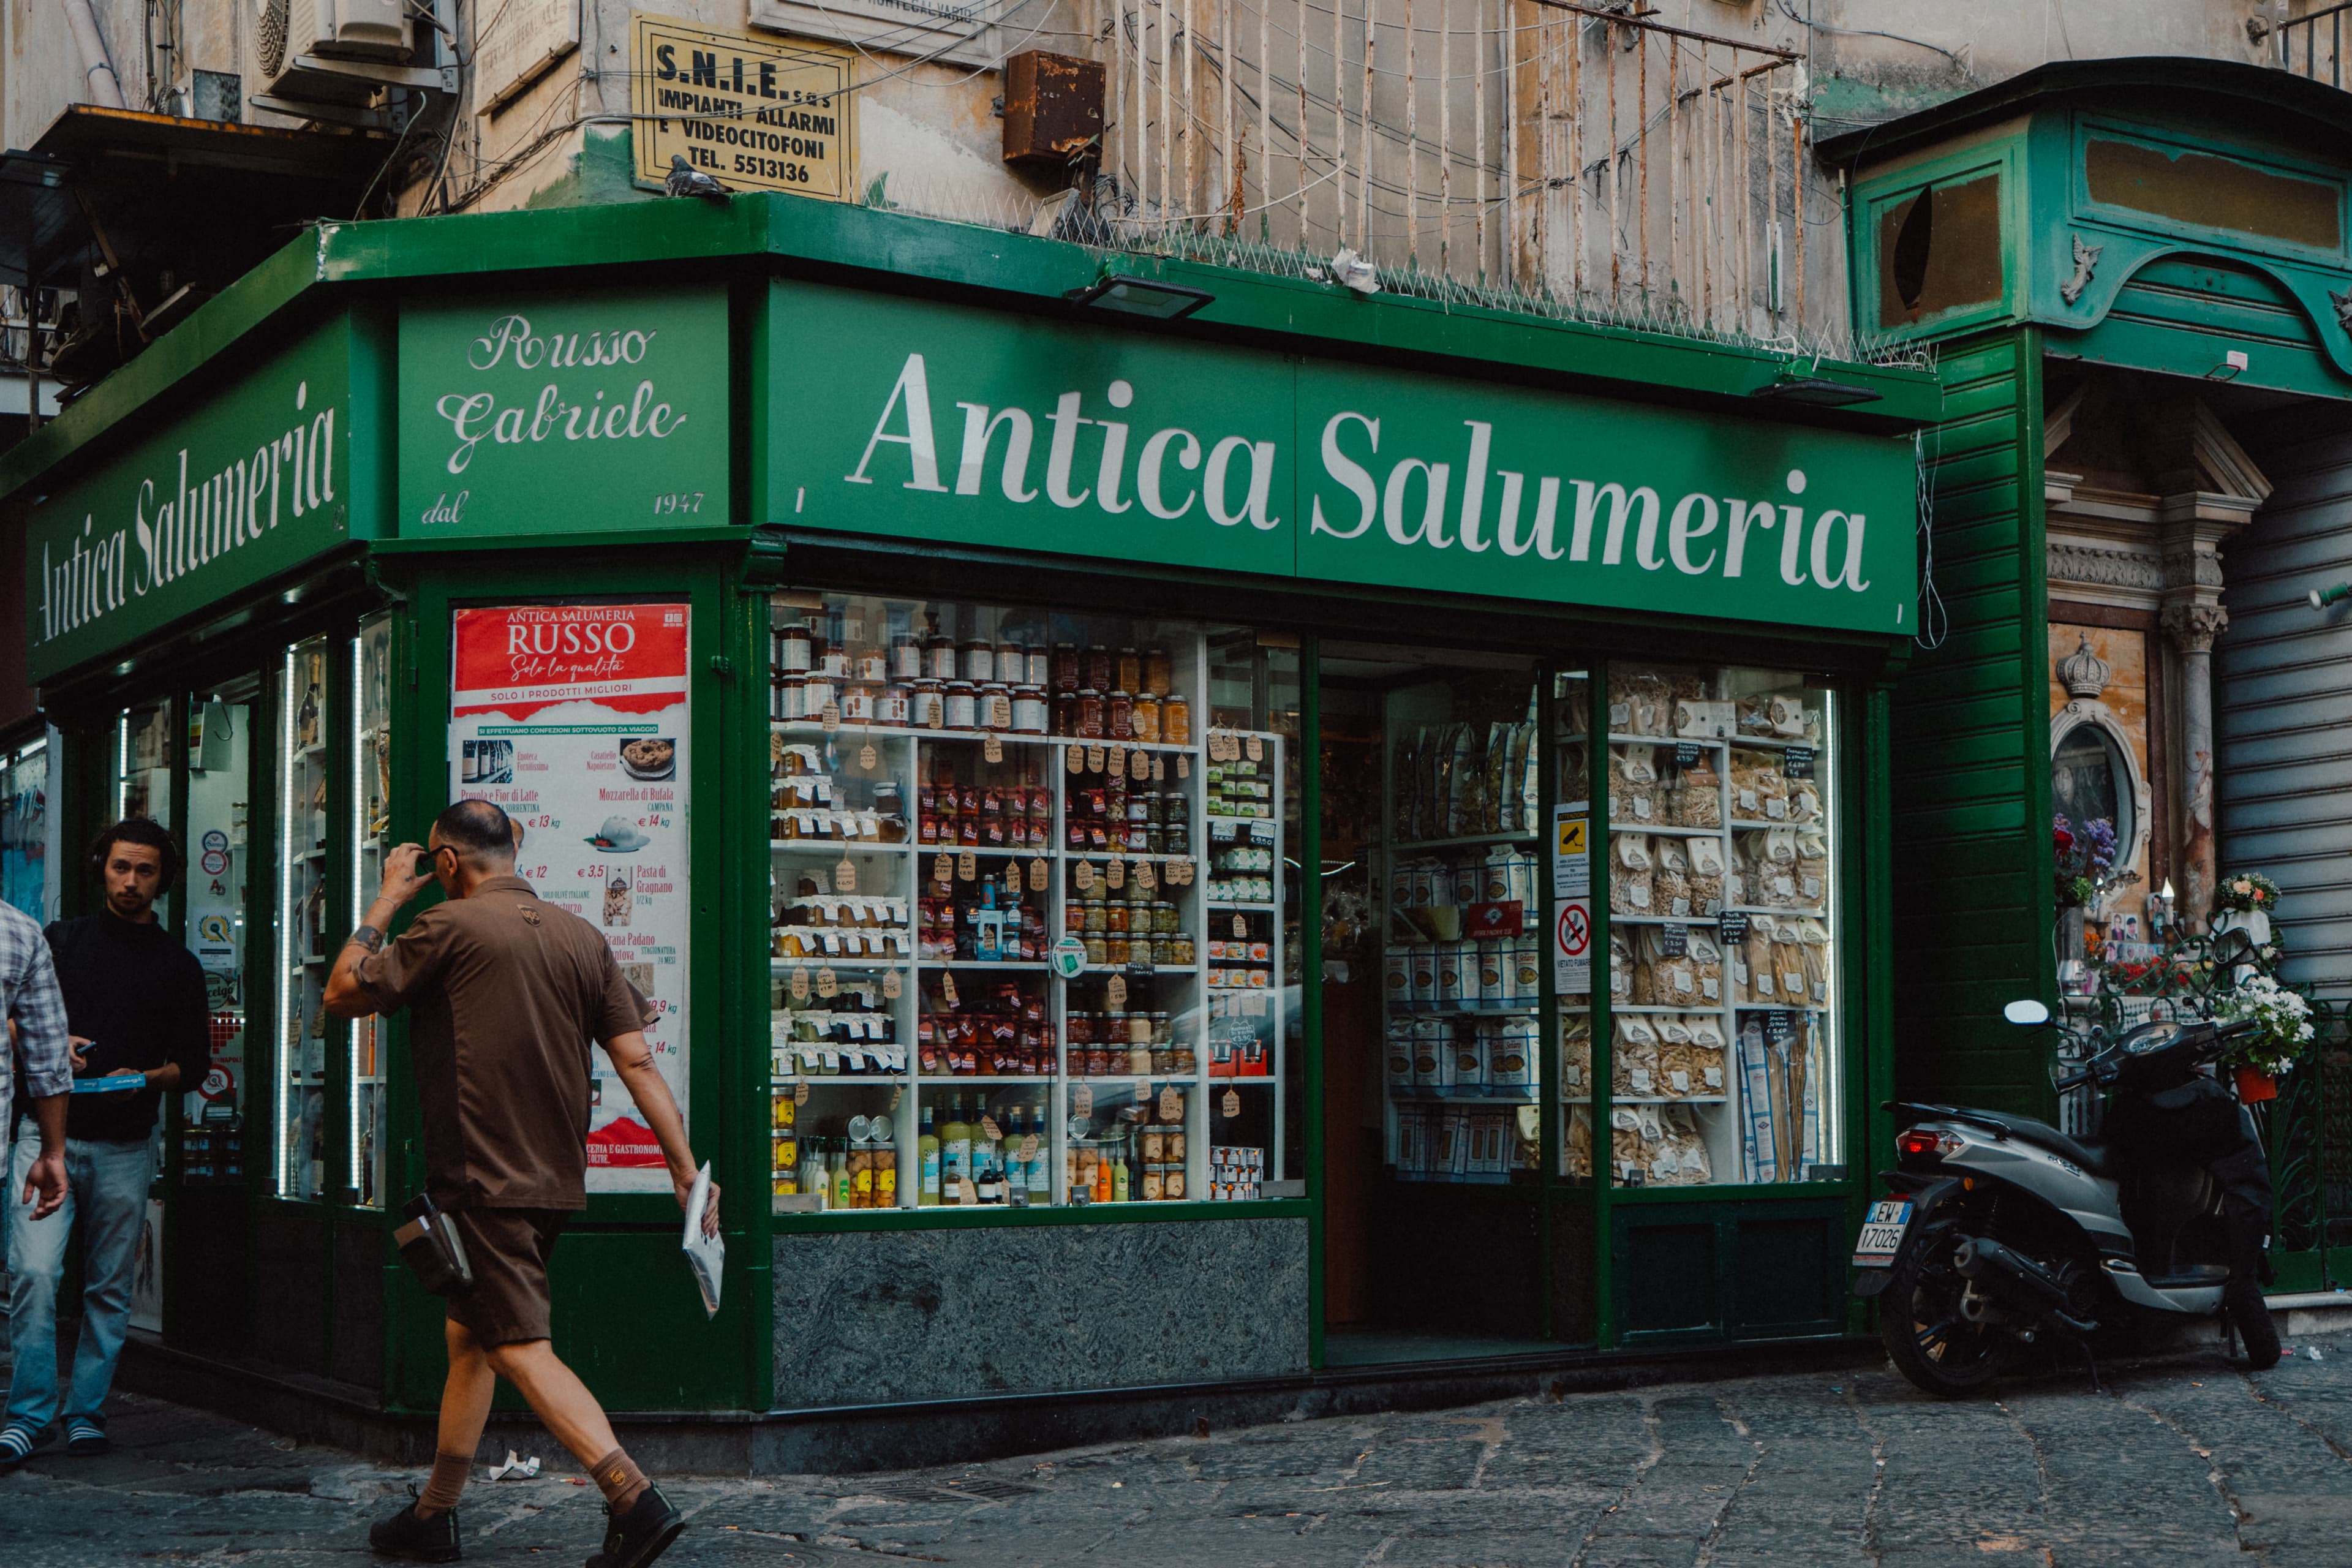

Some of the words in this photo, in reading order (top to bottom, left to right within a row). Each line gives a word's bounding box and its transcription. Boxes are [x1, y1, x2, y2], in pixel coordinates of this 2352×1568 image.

[658, 88, 742, 120] IMPIANTI
[756, 105, 835, 135] ALLARMI
[659, 118, 669, 133] E
[681, 118, 824, 159] VIDEOCITOFONI
[688, 146, 725, 170] TEL.
[734, 154, 809, 183] 5513136
[469, 313, 657, 370] Russo
[436, 379, 688, 473] Gabriele
[844, 353, 1281, 530] Antica
[1311, 411, 1871, 593] Salumeria
[34, 513, 126, 647] Antica
[135, 380, 335, 597] Salumeria
[421, 490, 469, 524] dal
[654, 492, 704, 514] 1947
[507, 611, 557, 623] ANTICA
[561, 609, 635, 622] SALUMERIA
[507, 622, 635, 654] RUSSO
[511, 654, 545, 682] Solo
[548, 657, 569, 675] la
[570, 654, 624, 682] qualità
[491, 692, 518, 701] SOLO
[529, 687, 581, 699] PRODOTTI
[585, 684, 632, 695] MIGLIORI
[518, 752, 538, 761] Enoteca
[591, 750, 616, 760] Casatiello
[517, 762, 549, 771] Fornitissima
[587, 761, 616, 771] Napoletano
[461, 789, 488, 801] Provola
[489, 792, 494, 801] e
[495, 789, 510, 802] Fior
[511, 788, 518, 802] di
[520, 788, 539, 802] Latte
[599, 788, 639, 801] Mozzarella
[641, 788, 648, 801] di
[650, 788, 674, 801] Bufala
[505, 804, 540, 813] SORRENTINA
[647, 802, 674, 812] CAMPANA
[529, 819, 537, 827] €
[539, 815, 550, 827] 13
[551, 819, 560, 829] kg
[638, 818, 646, 827] €
[649, 814, 659, 826] 14
[661, 818, 670, 828] kg
[526, 869, 533, 878] €
[537, 865, 548, 878] 12
[578, 869, 586, 877] €
[588, 865, 605, 878] 3,5
[637, 865, 657, 878] Pasta
[658, 865, 666, 878] di
[636, 880, 673, 894] Gragnano
[568, 890, 590, 899] ITALIANE
[645, 895, 652, 905] kg
[628, 932, 655, 946] Padano
[641, 946, 676, 955] STAGIONATURA
[664, 956, 676, 965] MESI
[648, 1000, 666, 1012] 9,9
[668, 1004, 677, 1014] kg
[655, 1041, 666, 1054] 14
[667, 1045, 677, 1055] kg
[609, 1144, 612, 1154] E
[1876, 1203, 1896, 1223] EW
[1862, 1228, 1899, 1248] 17026
